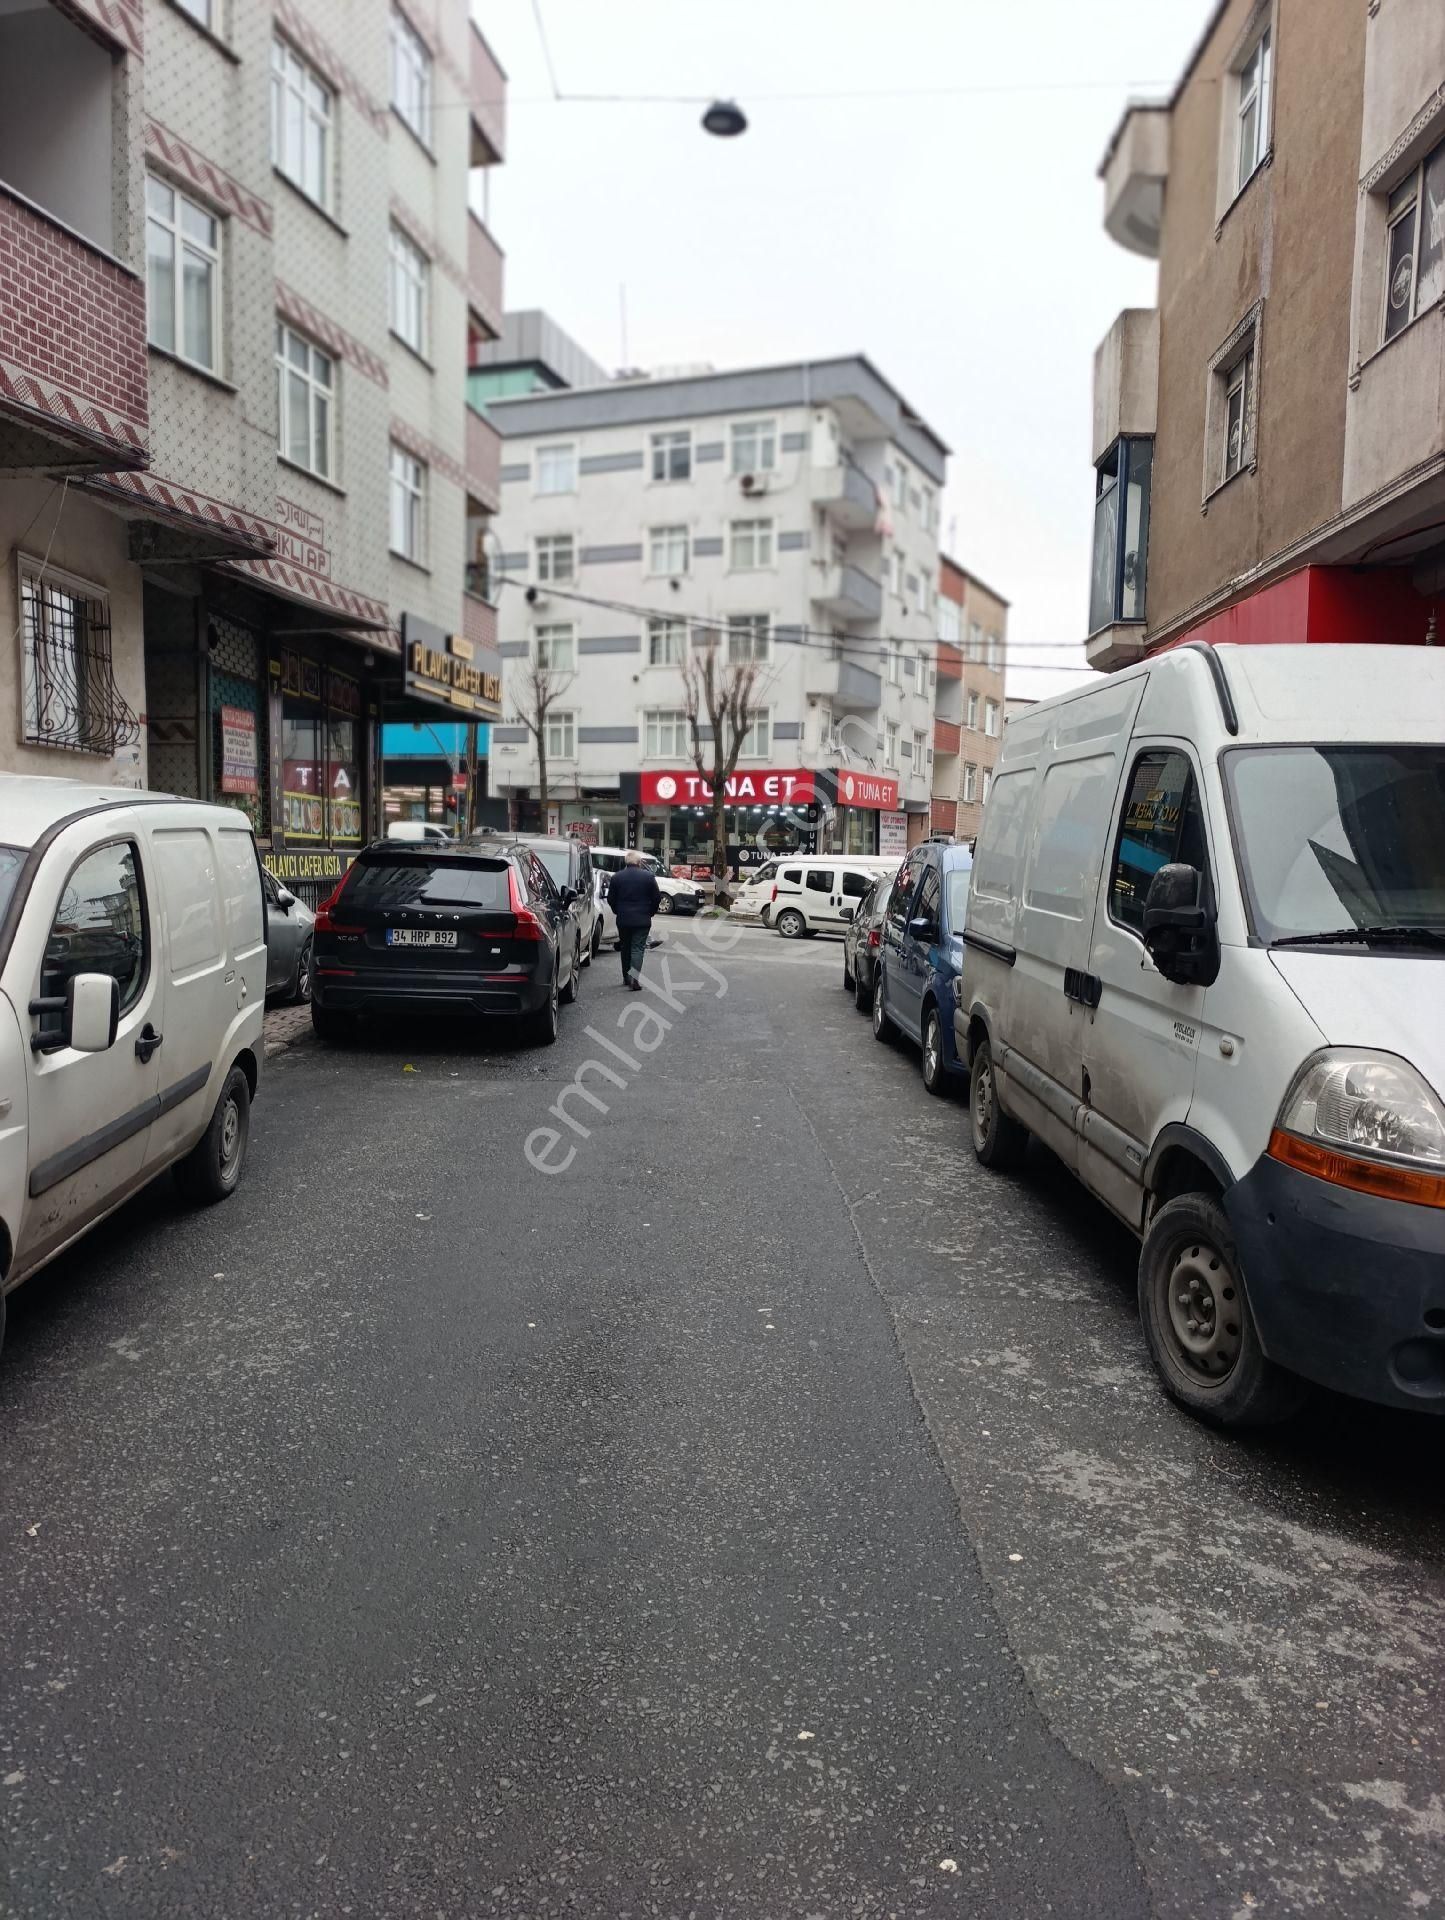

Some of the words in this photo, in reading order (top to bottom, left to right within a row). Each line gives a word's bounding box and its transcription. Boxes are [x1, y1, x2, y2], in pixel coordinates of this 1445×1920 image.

[453, 659, 480, 695] CAFER
[483, 671, 503, 702] USTA
[685, 776, 756, 797] TUNA
[764, 776, 797, 797] ET
[858, 781, 880, 801] TUNA
[882, 786, 893, 802] ET
[265, 855, 298, 877] PİLAVCI
[299, 855, 322, 876] CAFER
[323, 855, 342, 876] USTA
[383, 912, 460, 921] VOLVO
[393, 930, 406, 942] 34
[410, 931, 430, 943] HRP
[434, 932, 454, 944] 892
